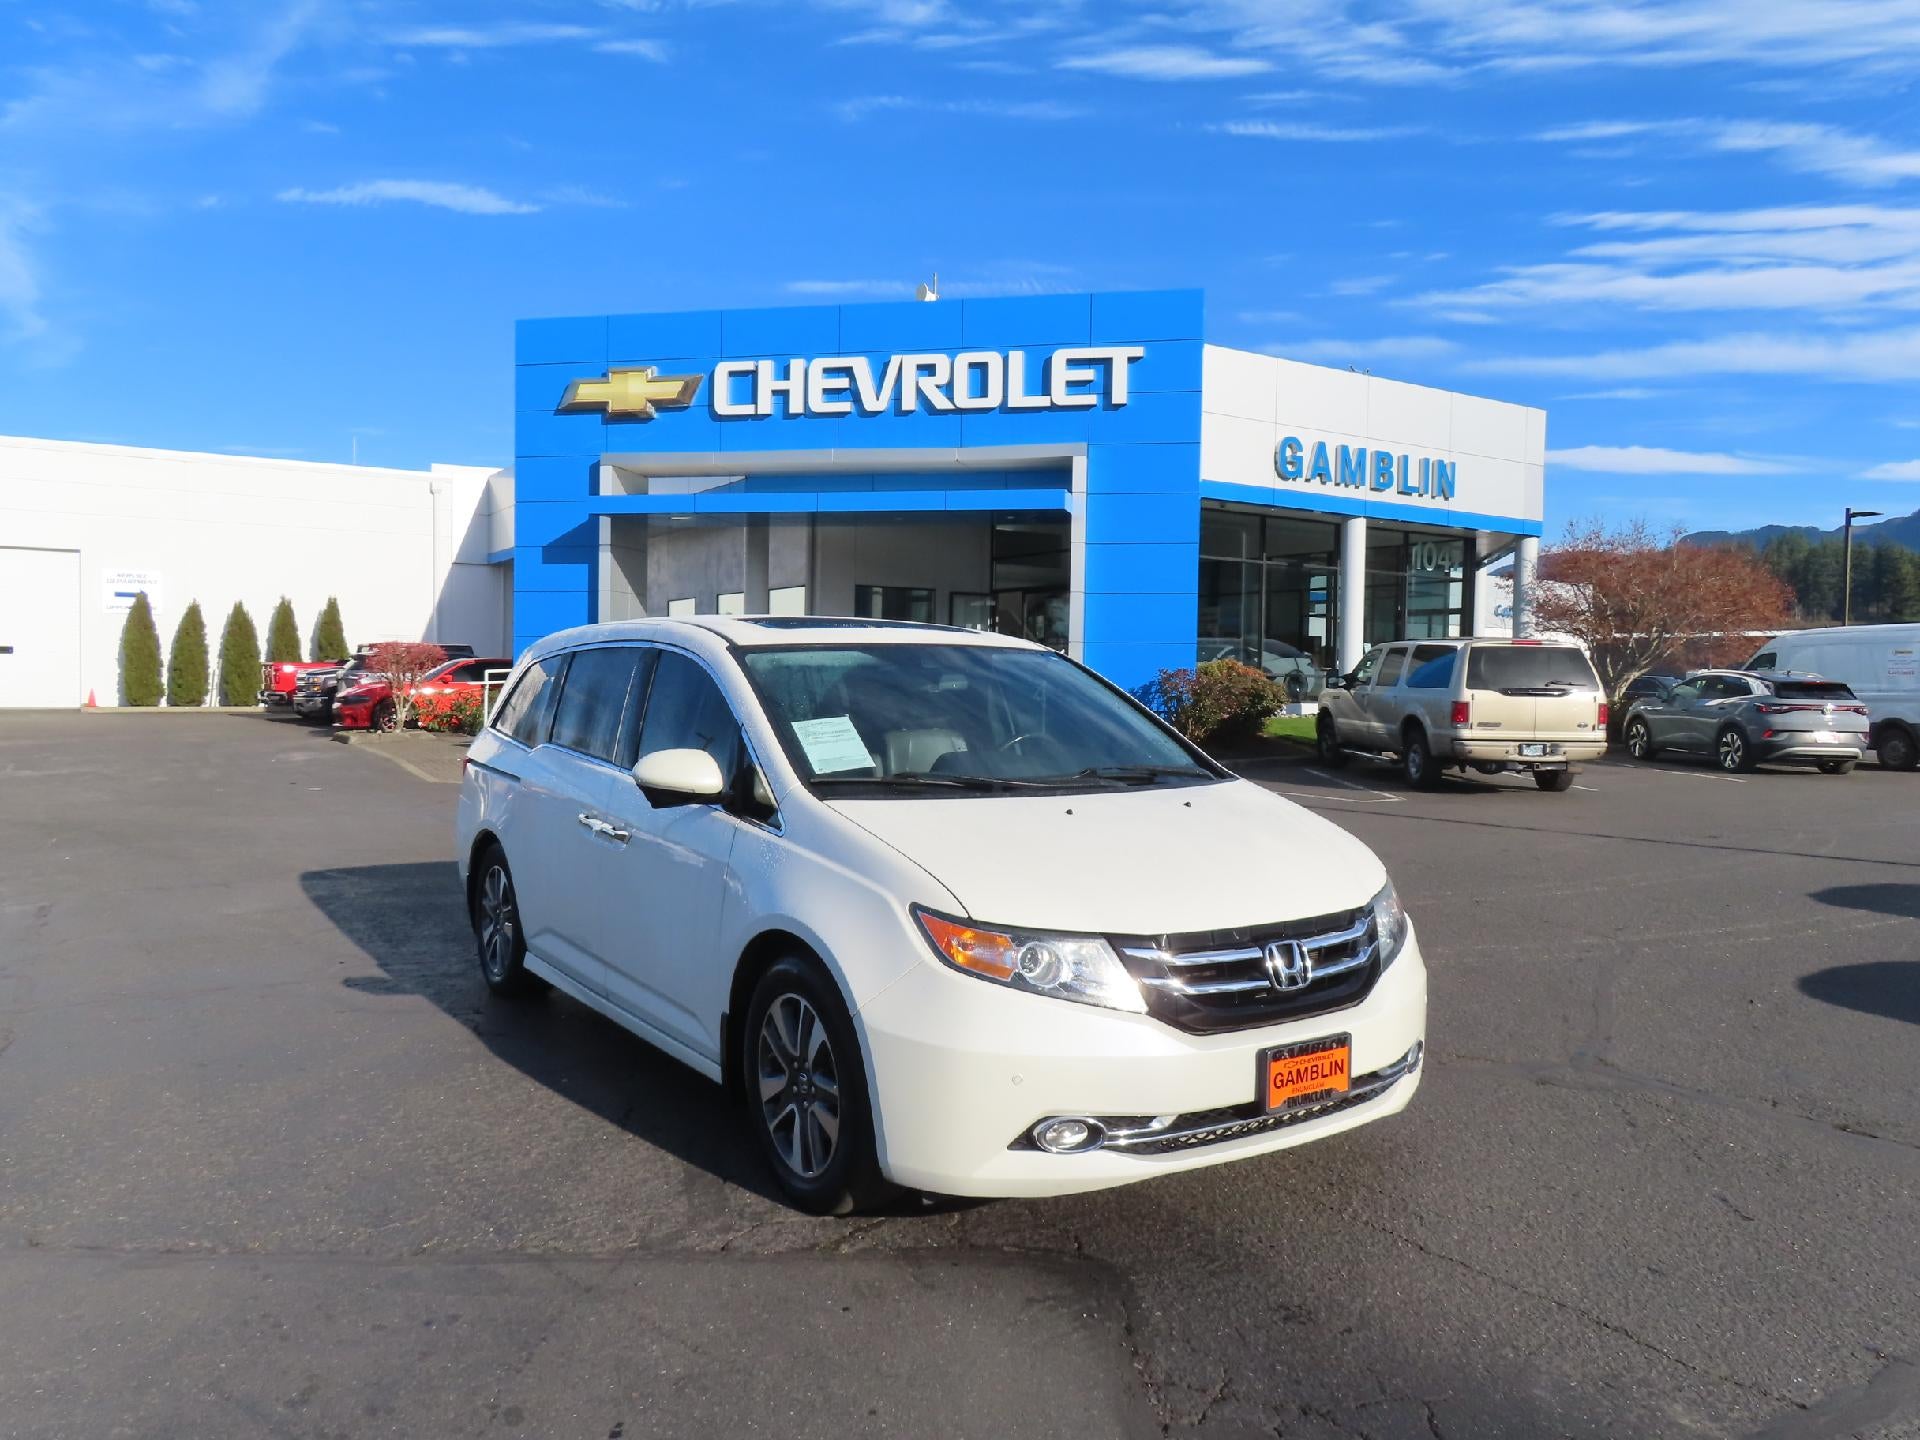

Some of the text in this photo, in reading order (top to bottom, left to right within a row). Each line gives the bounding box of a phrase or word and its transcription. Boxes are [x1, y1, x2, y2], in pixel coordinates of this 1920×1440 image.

[712, 346, 1145, 416] CHEVROLET
[1274, 436, 1456, 501] GAMBLIN
[1273, 1059, 1344, 1089] GAMBLIN
